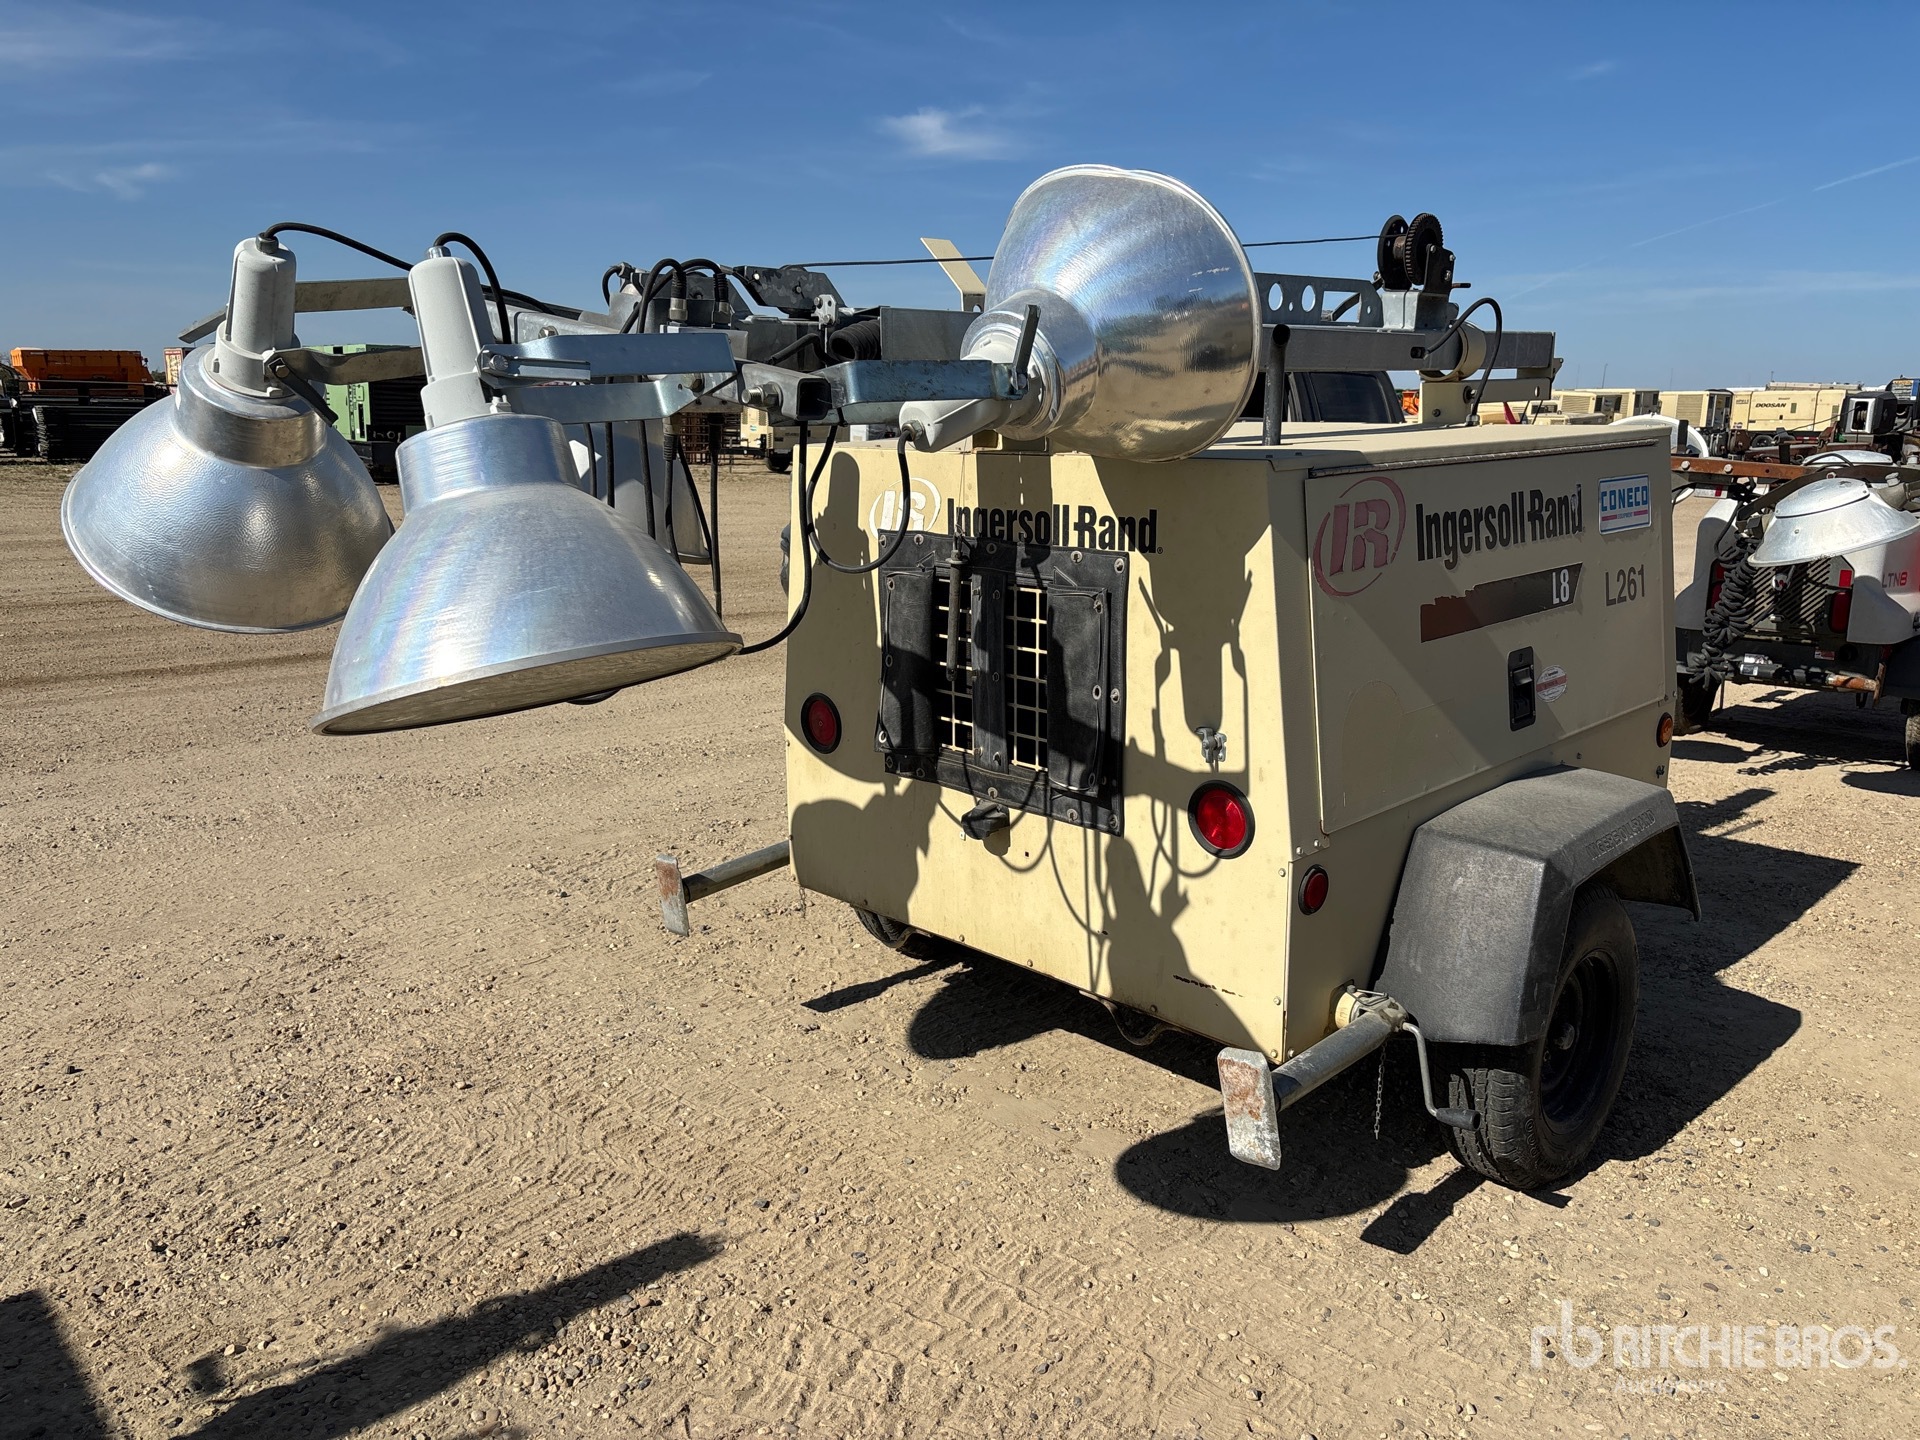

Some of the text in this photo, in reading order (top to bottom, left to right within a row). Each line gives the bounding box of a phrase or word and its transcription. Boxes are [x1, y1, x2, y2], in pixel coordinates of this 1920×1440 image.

[1601, 485, 1648, 512] CONECO
[1552, 568, 1570, 604] L8
[1604, 563, 1646, 607] L261
